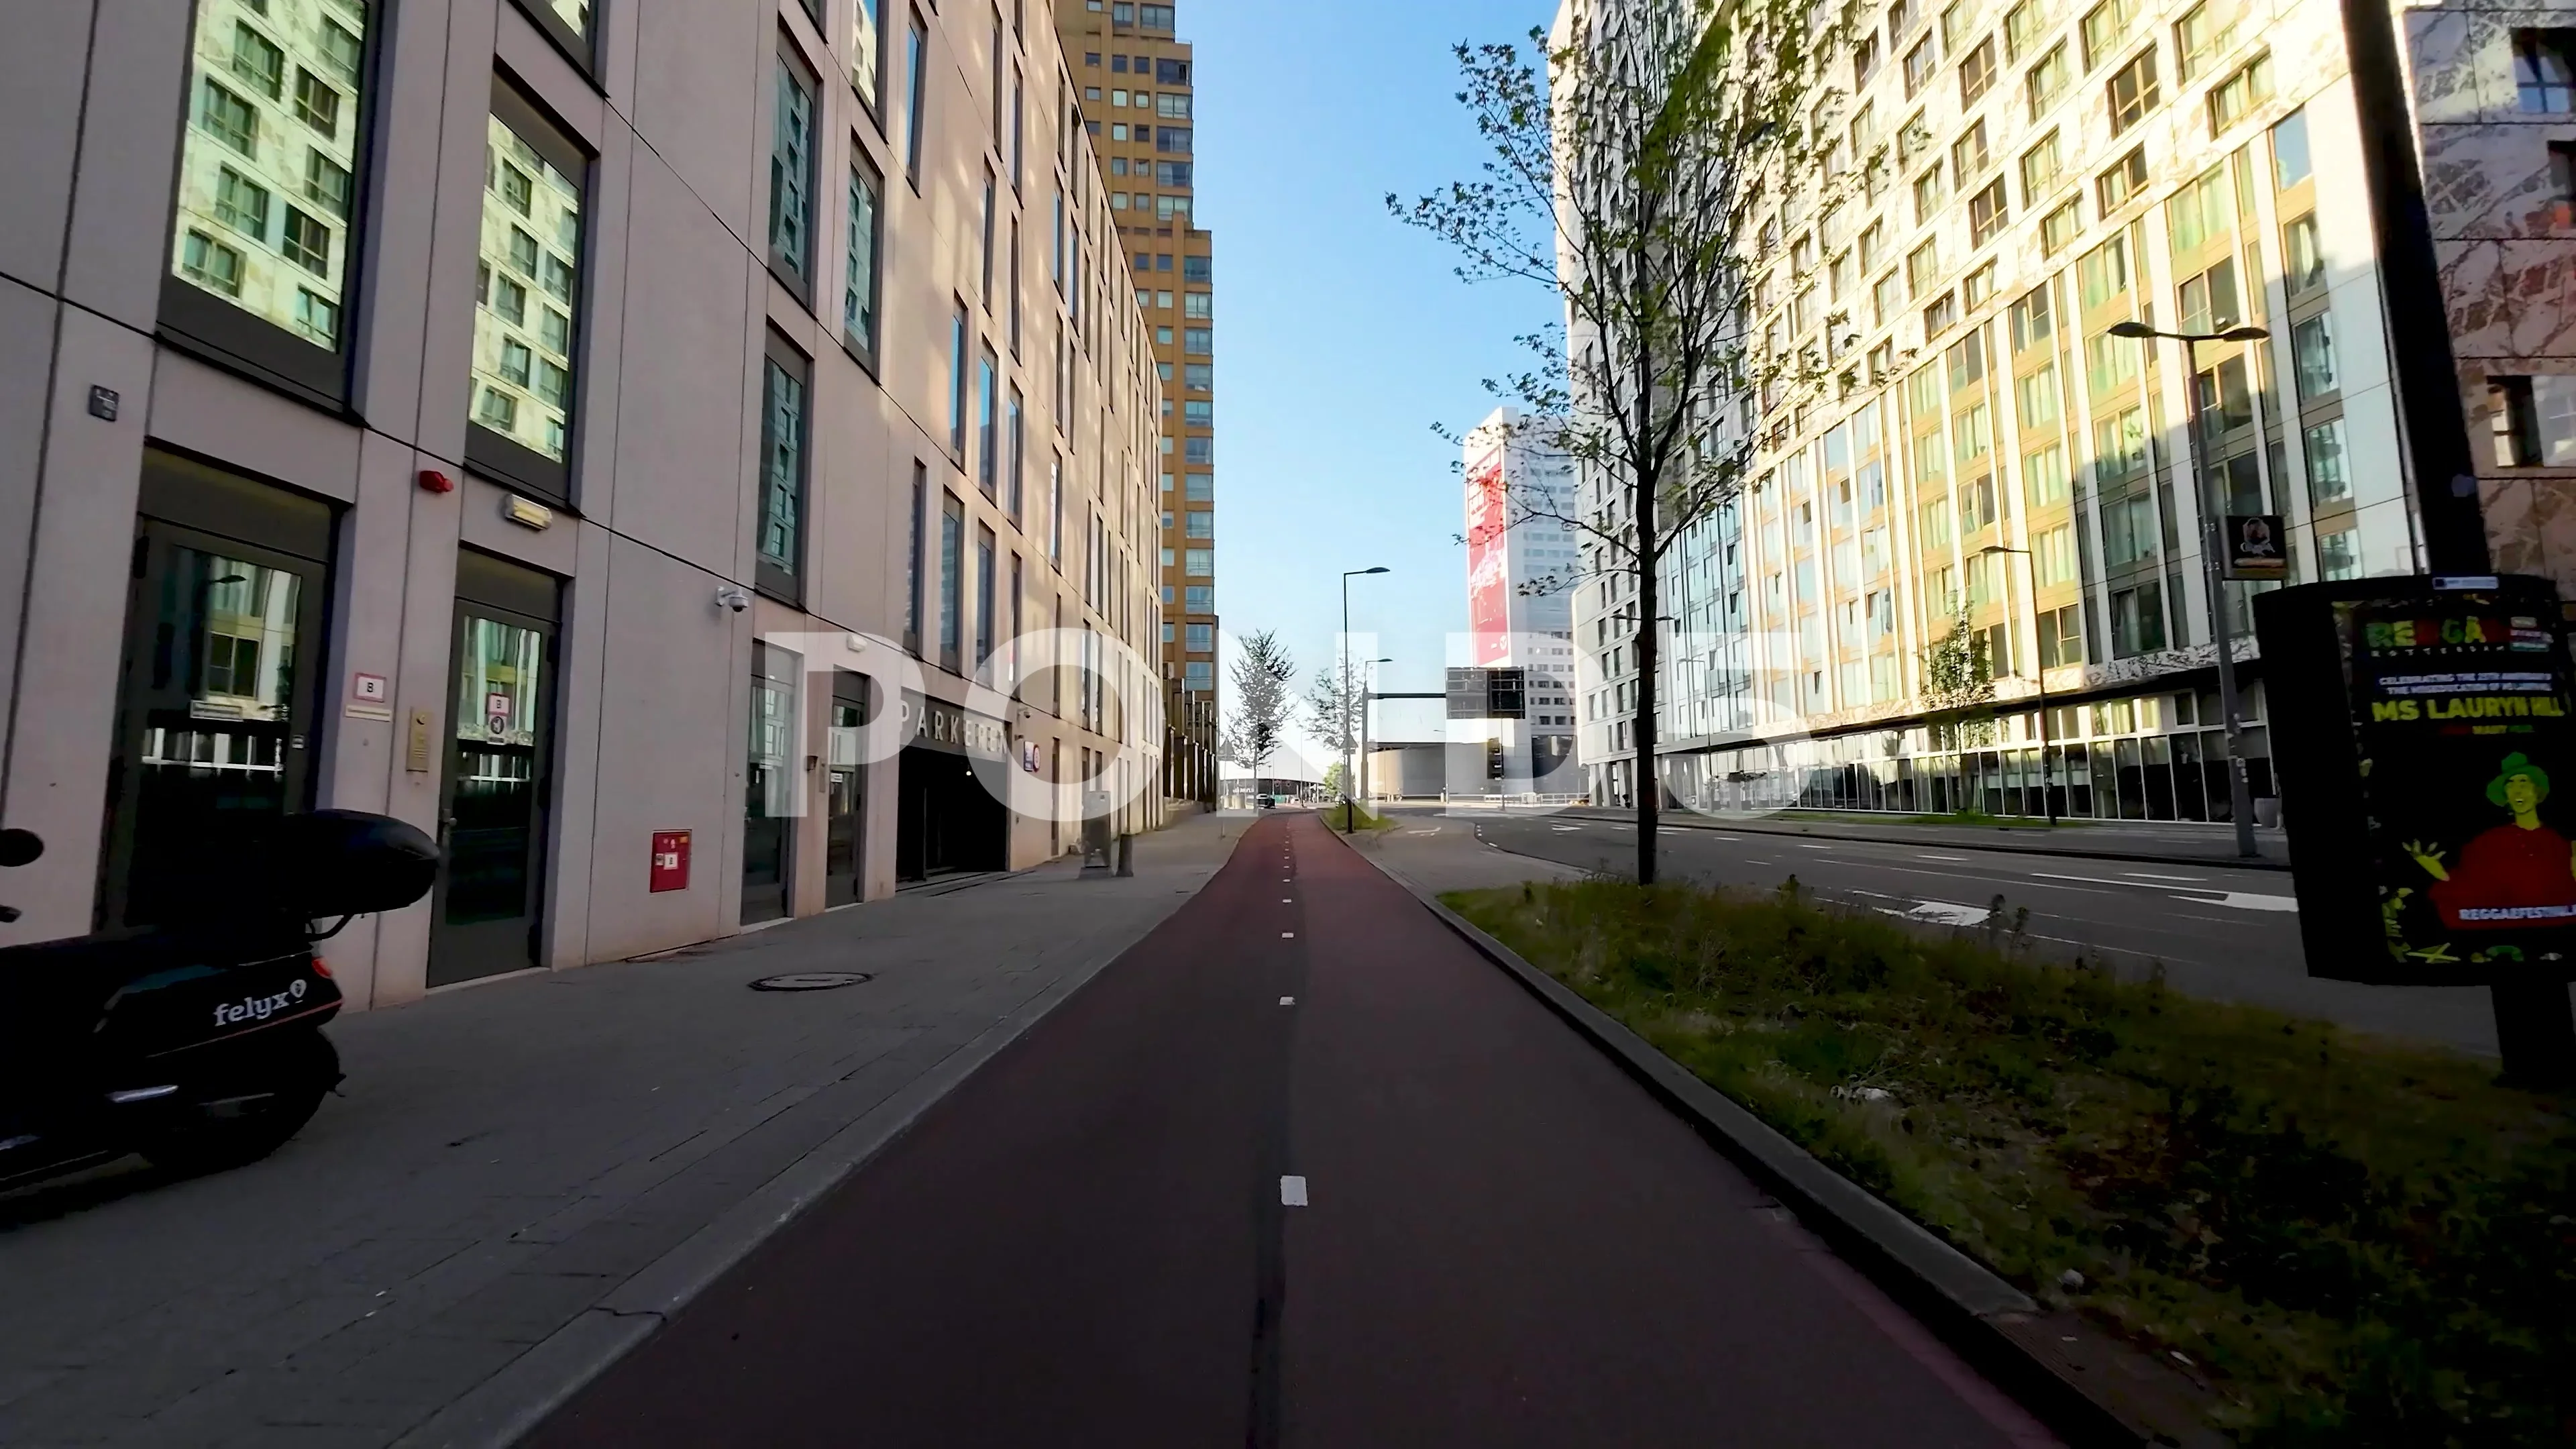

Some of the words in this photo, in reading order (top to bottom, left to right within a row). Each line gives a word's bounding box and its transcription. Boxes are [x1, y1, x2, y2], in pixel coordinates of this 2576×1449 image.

[2371, 700, 2421, 722] MS
[2426, 697, 2529, 720] LAURYN
[213, 991, 283, 1026] felyx
